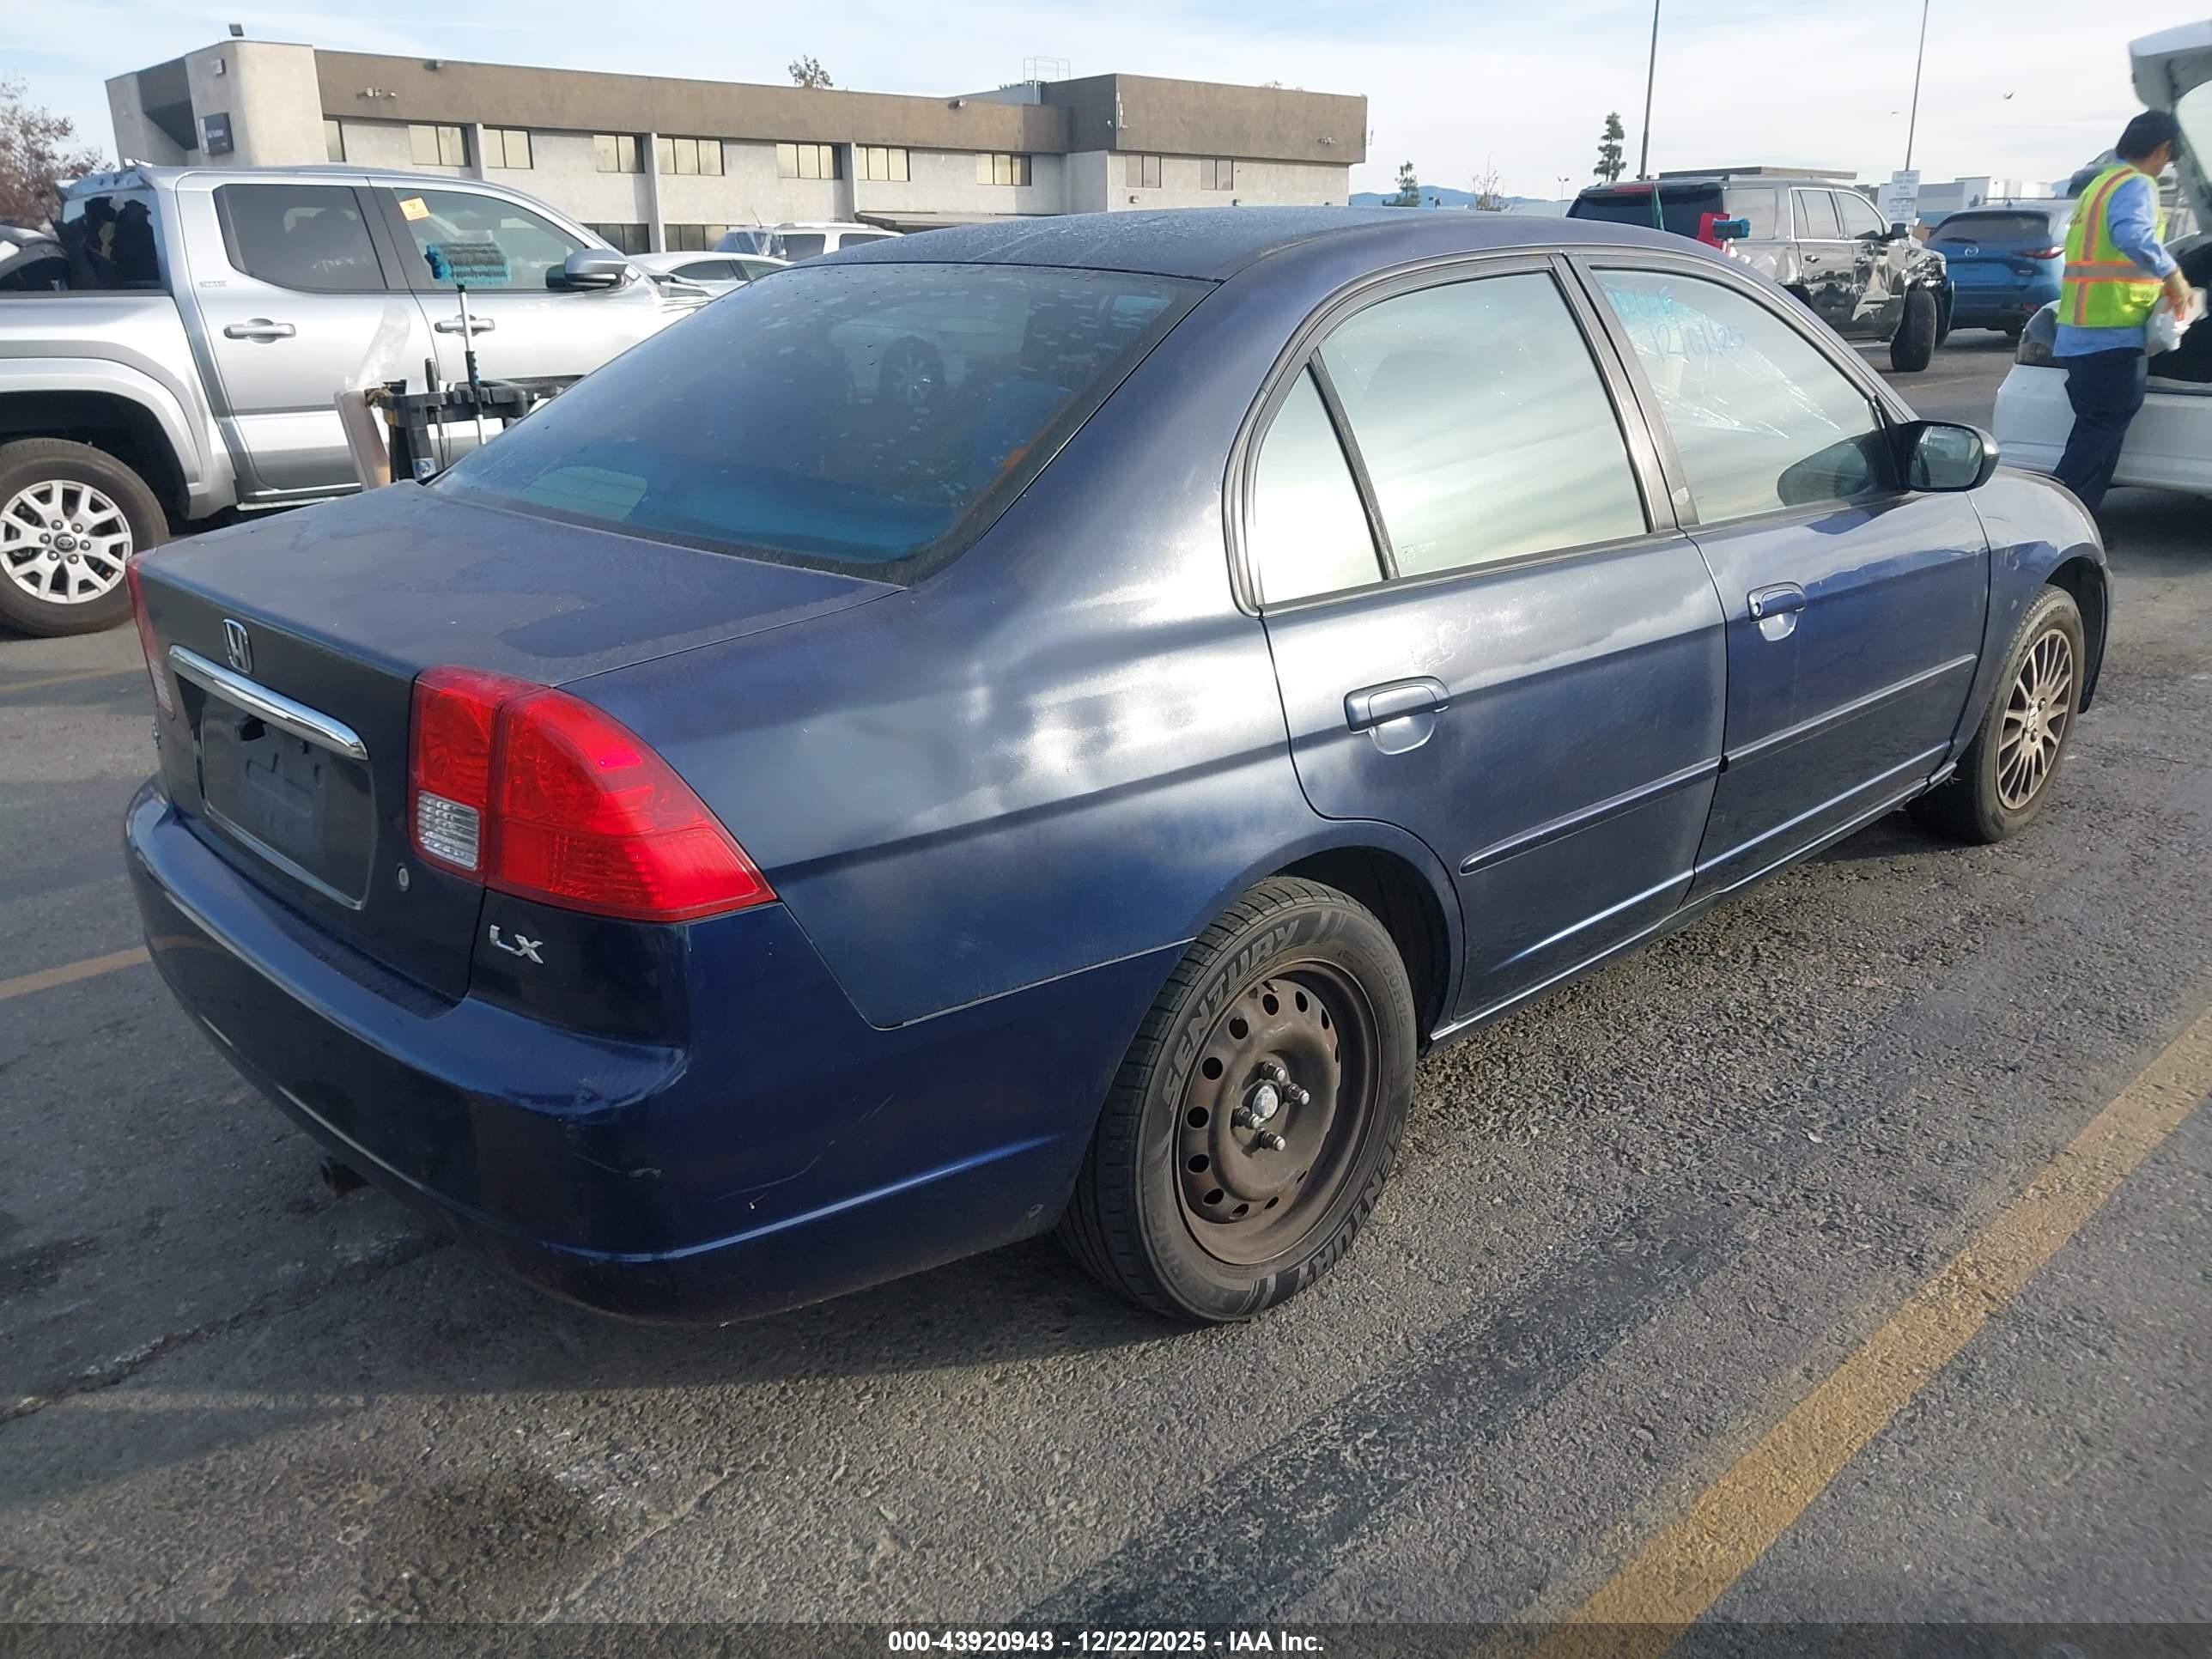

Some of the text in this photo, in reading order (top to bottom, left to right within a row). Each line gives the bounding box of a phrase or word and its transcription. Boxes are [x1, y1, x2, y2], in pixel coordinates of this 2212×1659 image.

[489, 924, 544, 963] LX
[1162, 920, 1300, 1111] SENTURY
[1297, 1114, 1403, 1290] SENTURY
